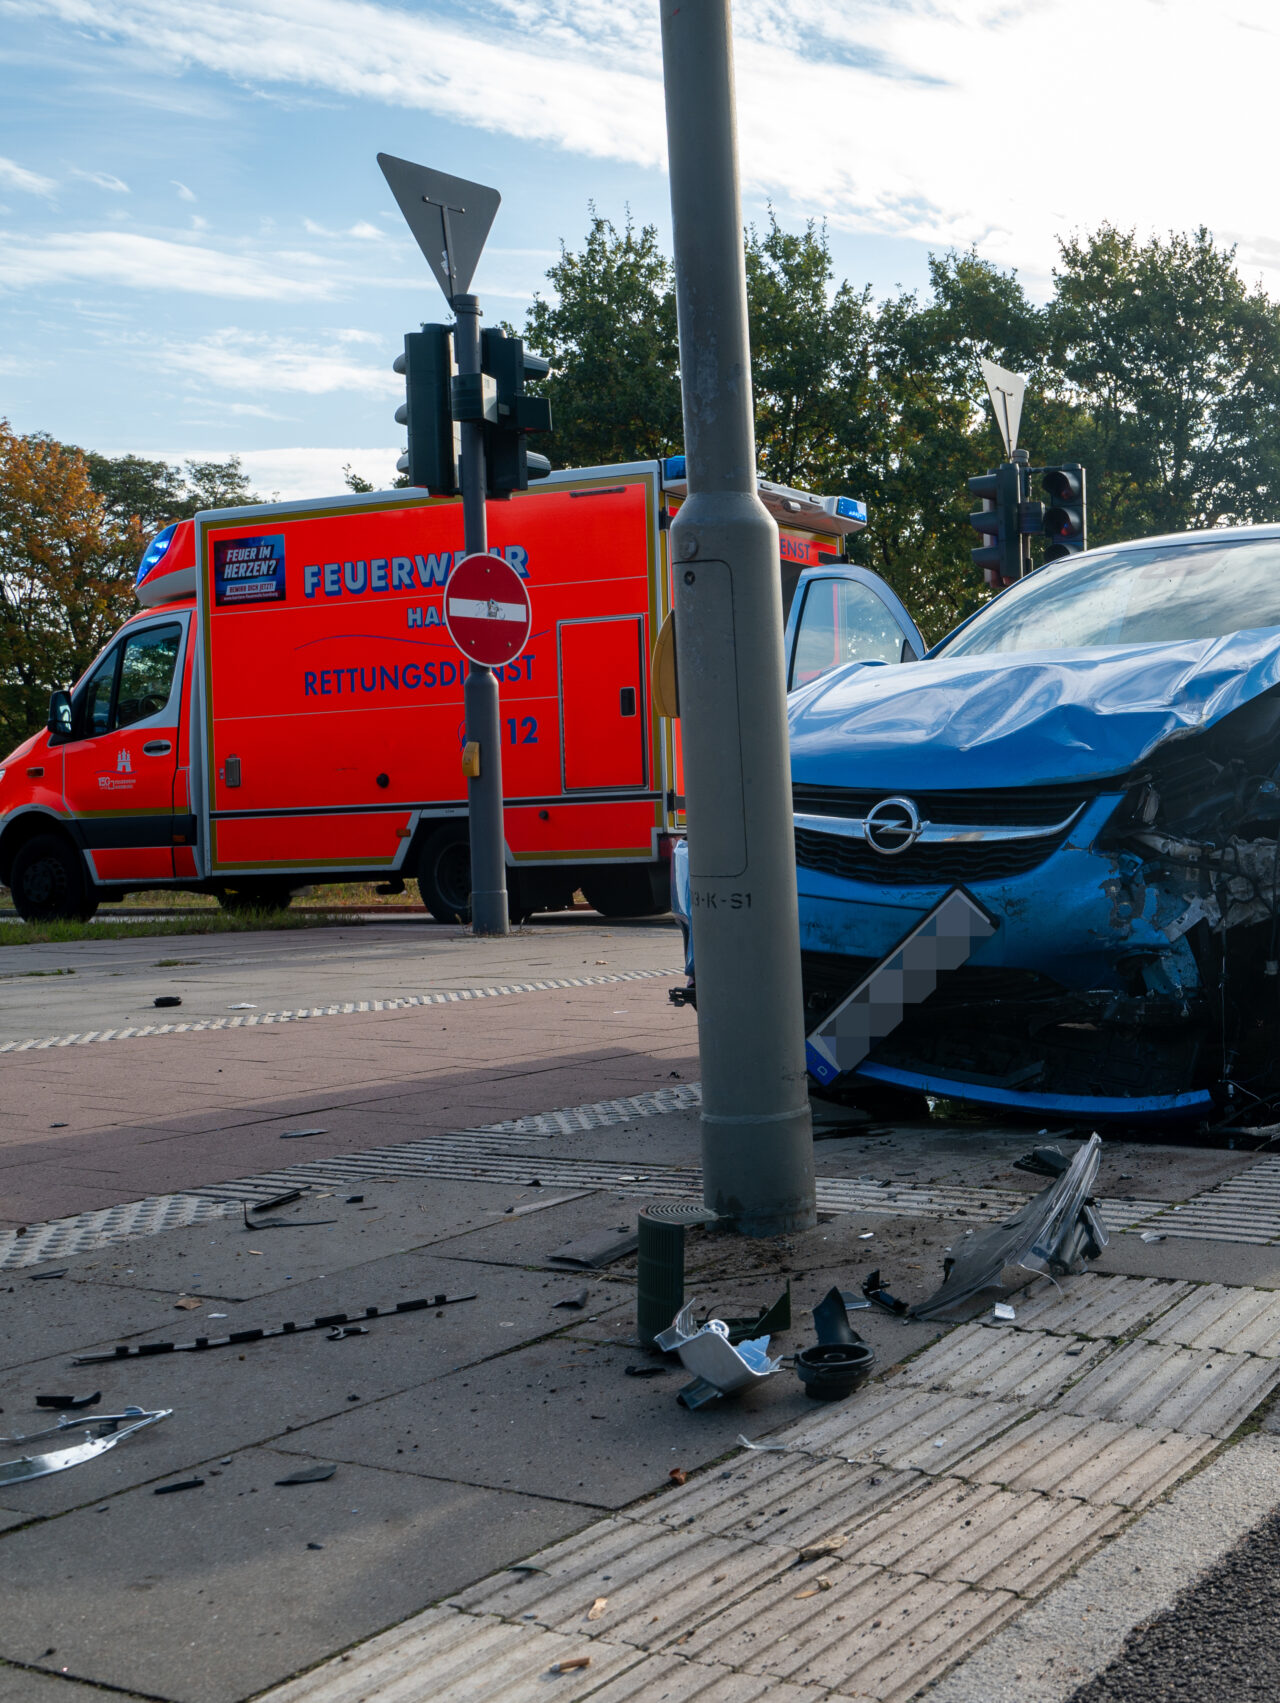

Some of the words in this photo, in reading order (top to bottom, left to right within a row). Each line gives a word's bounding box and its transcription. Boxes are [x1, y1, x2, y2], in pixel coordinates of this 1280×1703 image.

[226, 548, 257, 562] FEUER
[259, 546, 272, 559] IM
[780, 538, 811, 560] ENST
[224, 560, 277, 579] HERZEN?
[303, 545, 531, 598] FEUERWR
[304, 655, 536, 696] RETTUNGSDINST
[499, 716, 539, 745] 12
